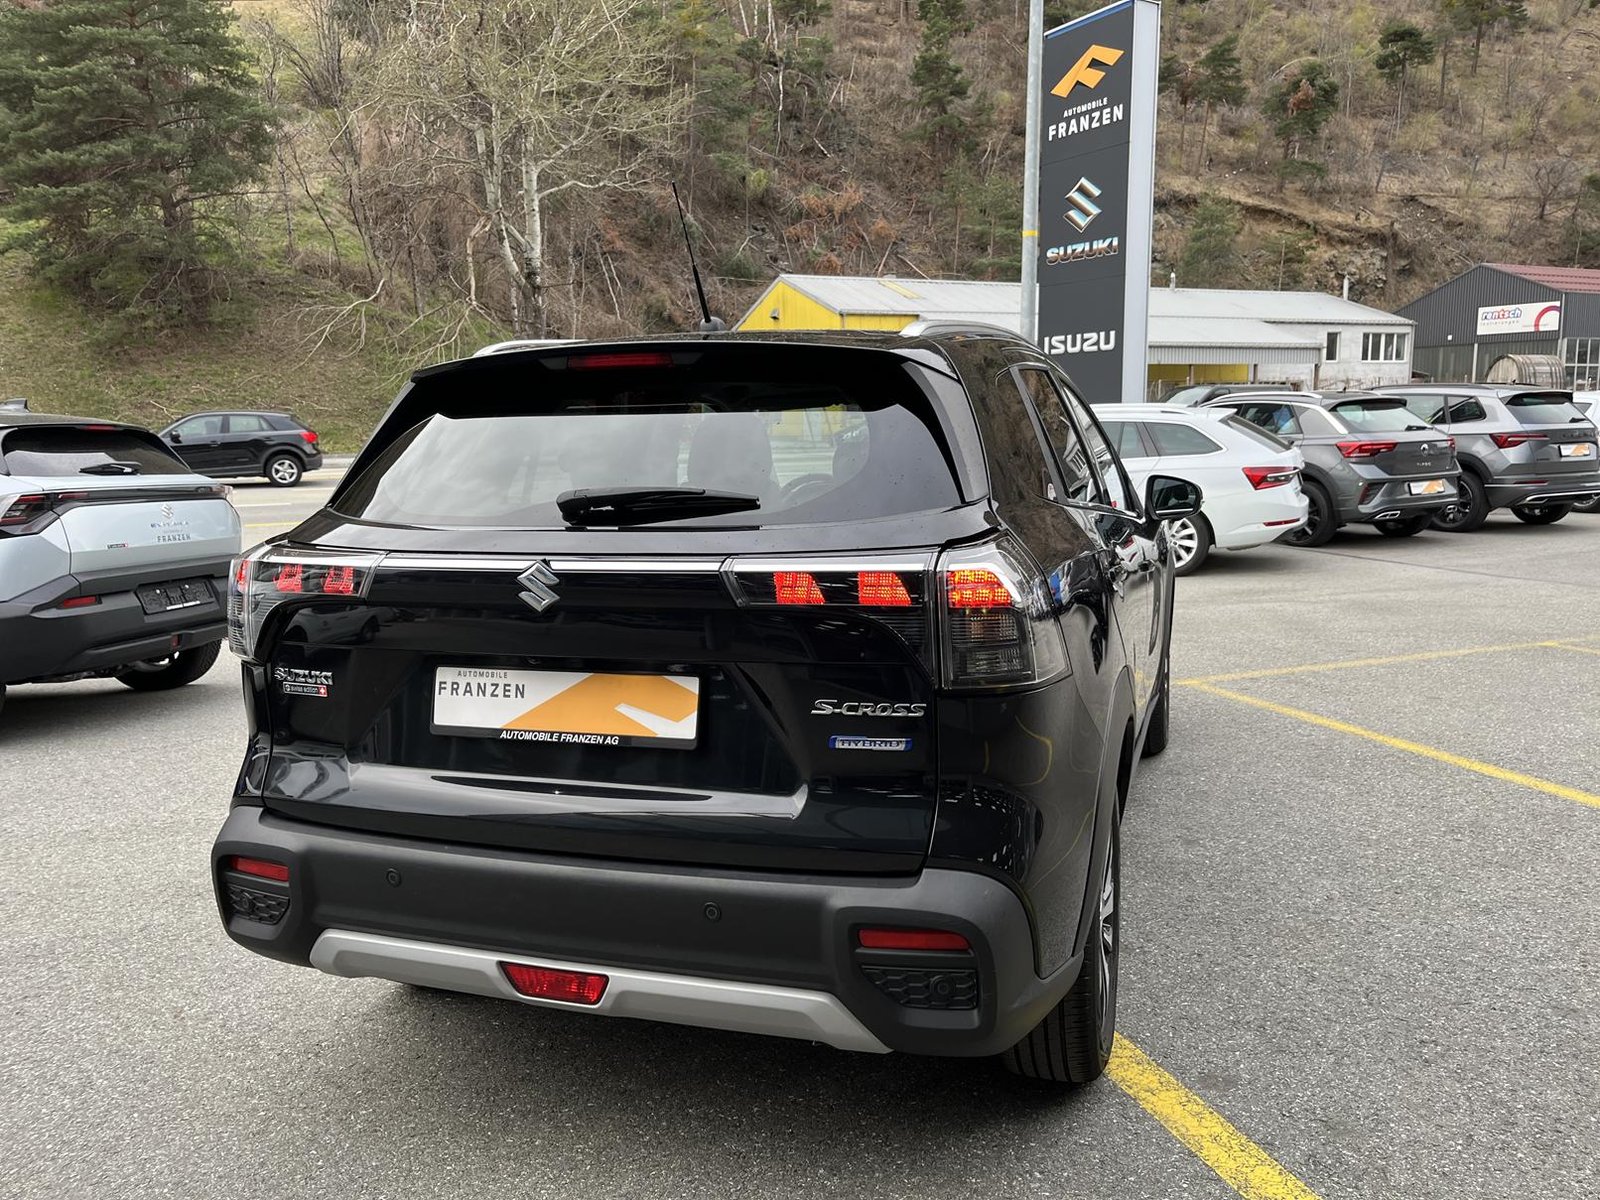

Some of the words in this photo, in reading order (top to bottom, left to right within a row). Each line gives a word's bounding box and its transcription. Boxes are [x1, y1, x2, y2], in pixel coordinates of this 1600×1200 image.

[1063, 97, 1108, 118] AUTOMOBILE
[1048, 104, 1123, 141] FRANZEN
[1046, 236, 1119, 266] SUZUKI
[1482, 307, 1522, 320] rentsch
[1043, 330, 1116, 355] ISUZU
[157, 533, 191, 543] FRANZEN
[274, 667, 333, 685] SUZUKI
[457, 670, 508, 679] AUTOMOBILE
[438, 681, 525, 699] FRANZEN
[811, 699, 927, 717] S-CROSS
[500, 730, 559, 742] AUTOMOBILE
[560, 732, 603, 744] FRANZEN
[603, 734, 619, 745] AG
[839, 739, 902, 749] HYBRID
